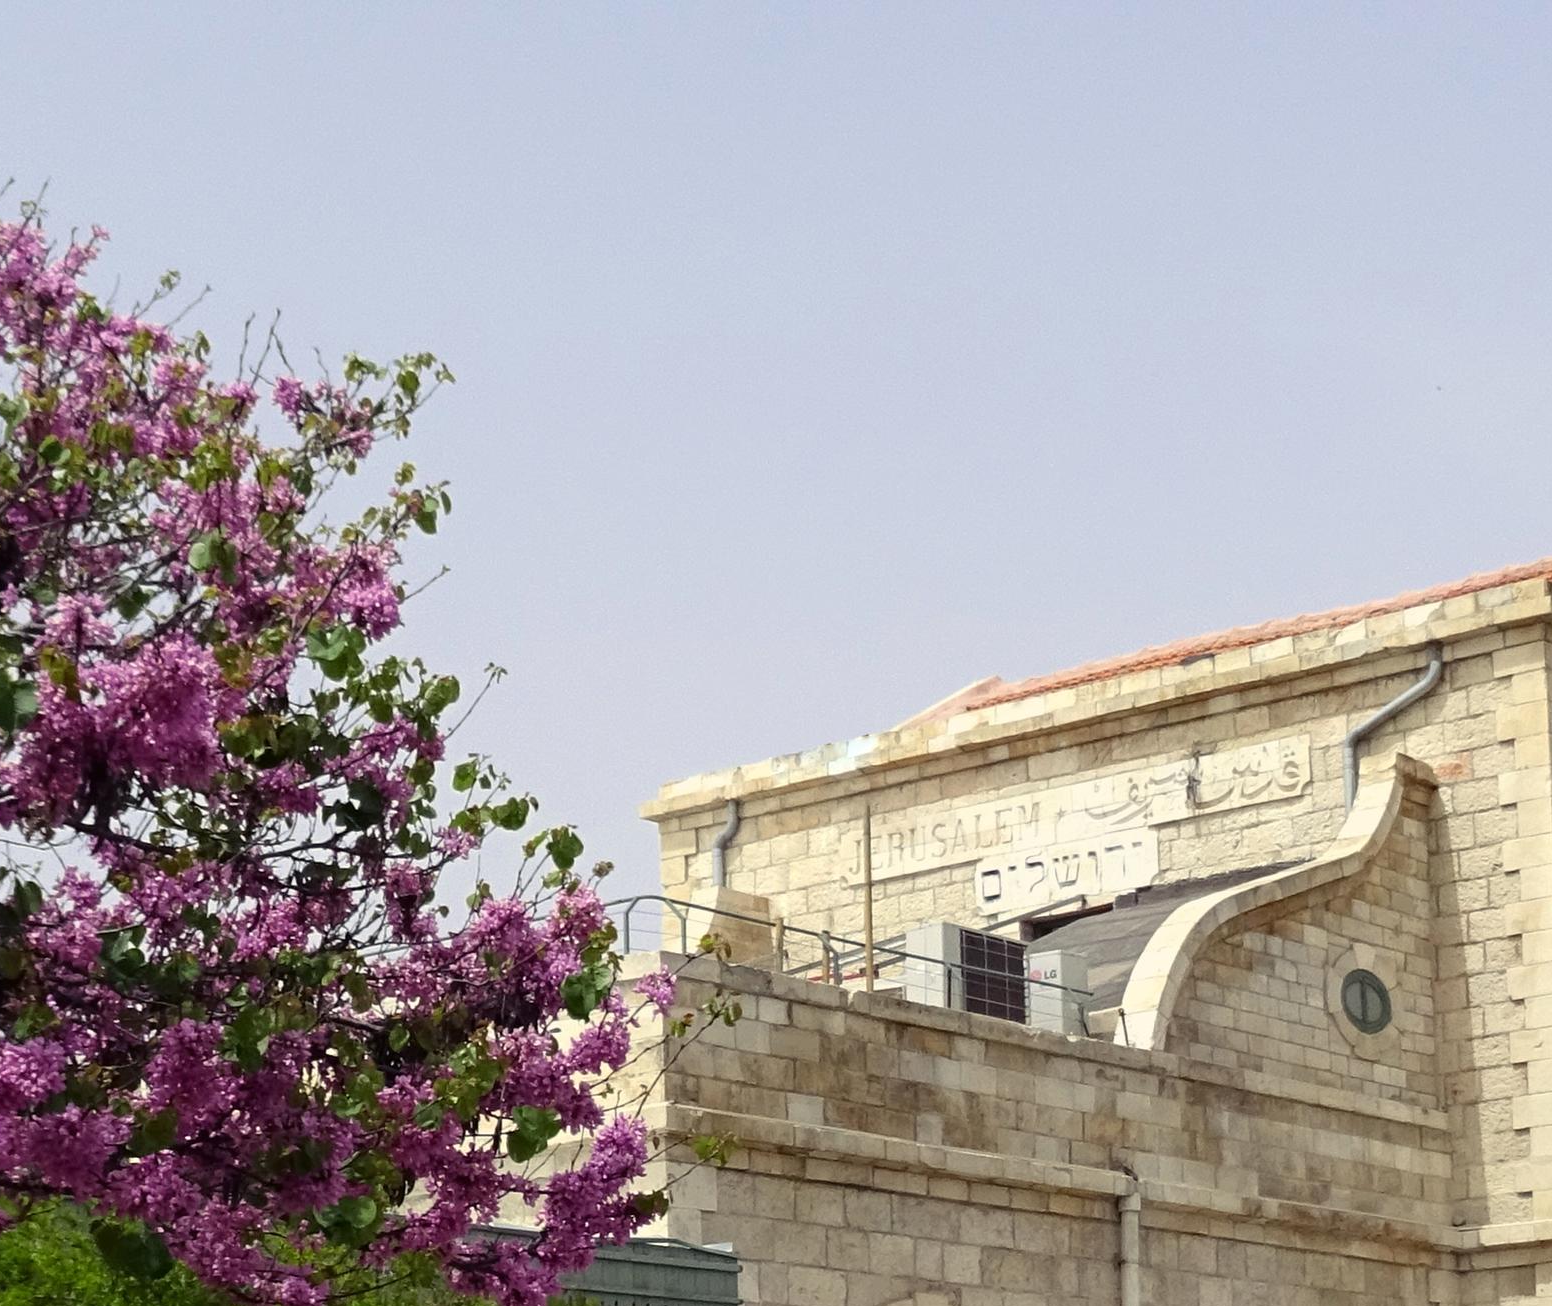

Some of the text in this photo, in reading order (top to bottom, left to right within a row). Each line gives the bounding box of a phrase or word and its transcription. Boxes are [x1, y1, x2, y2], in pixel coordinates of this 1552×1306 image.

[848, 801, 1042, 876] JERUSALEM
[980, 840, 1143, 903] ירושלים
[1043, 969, 1058, 980] LG
